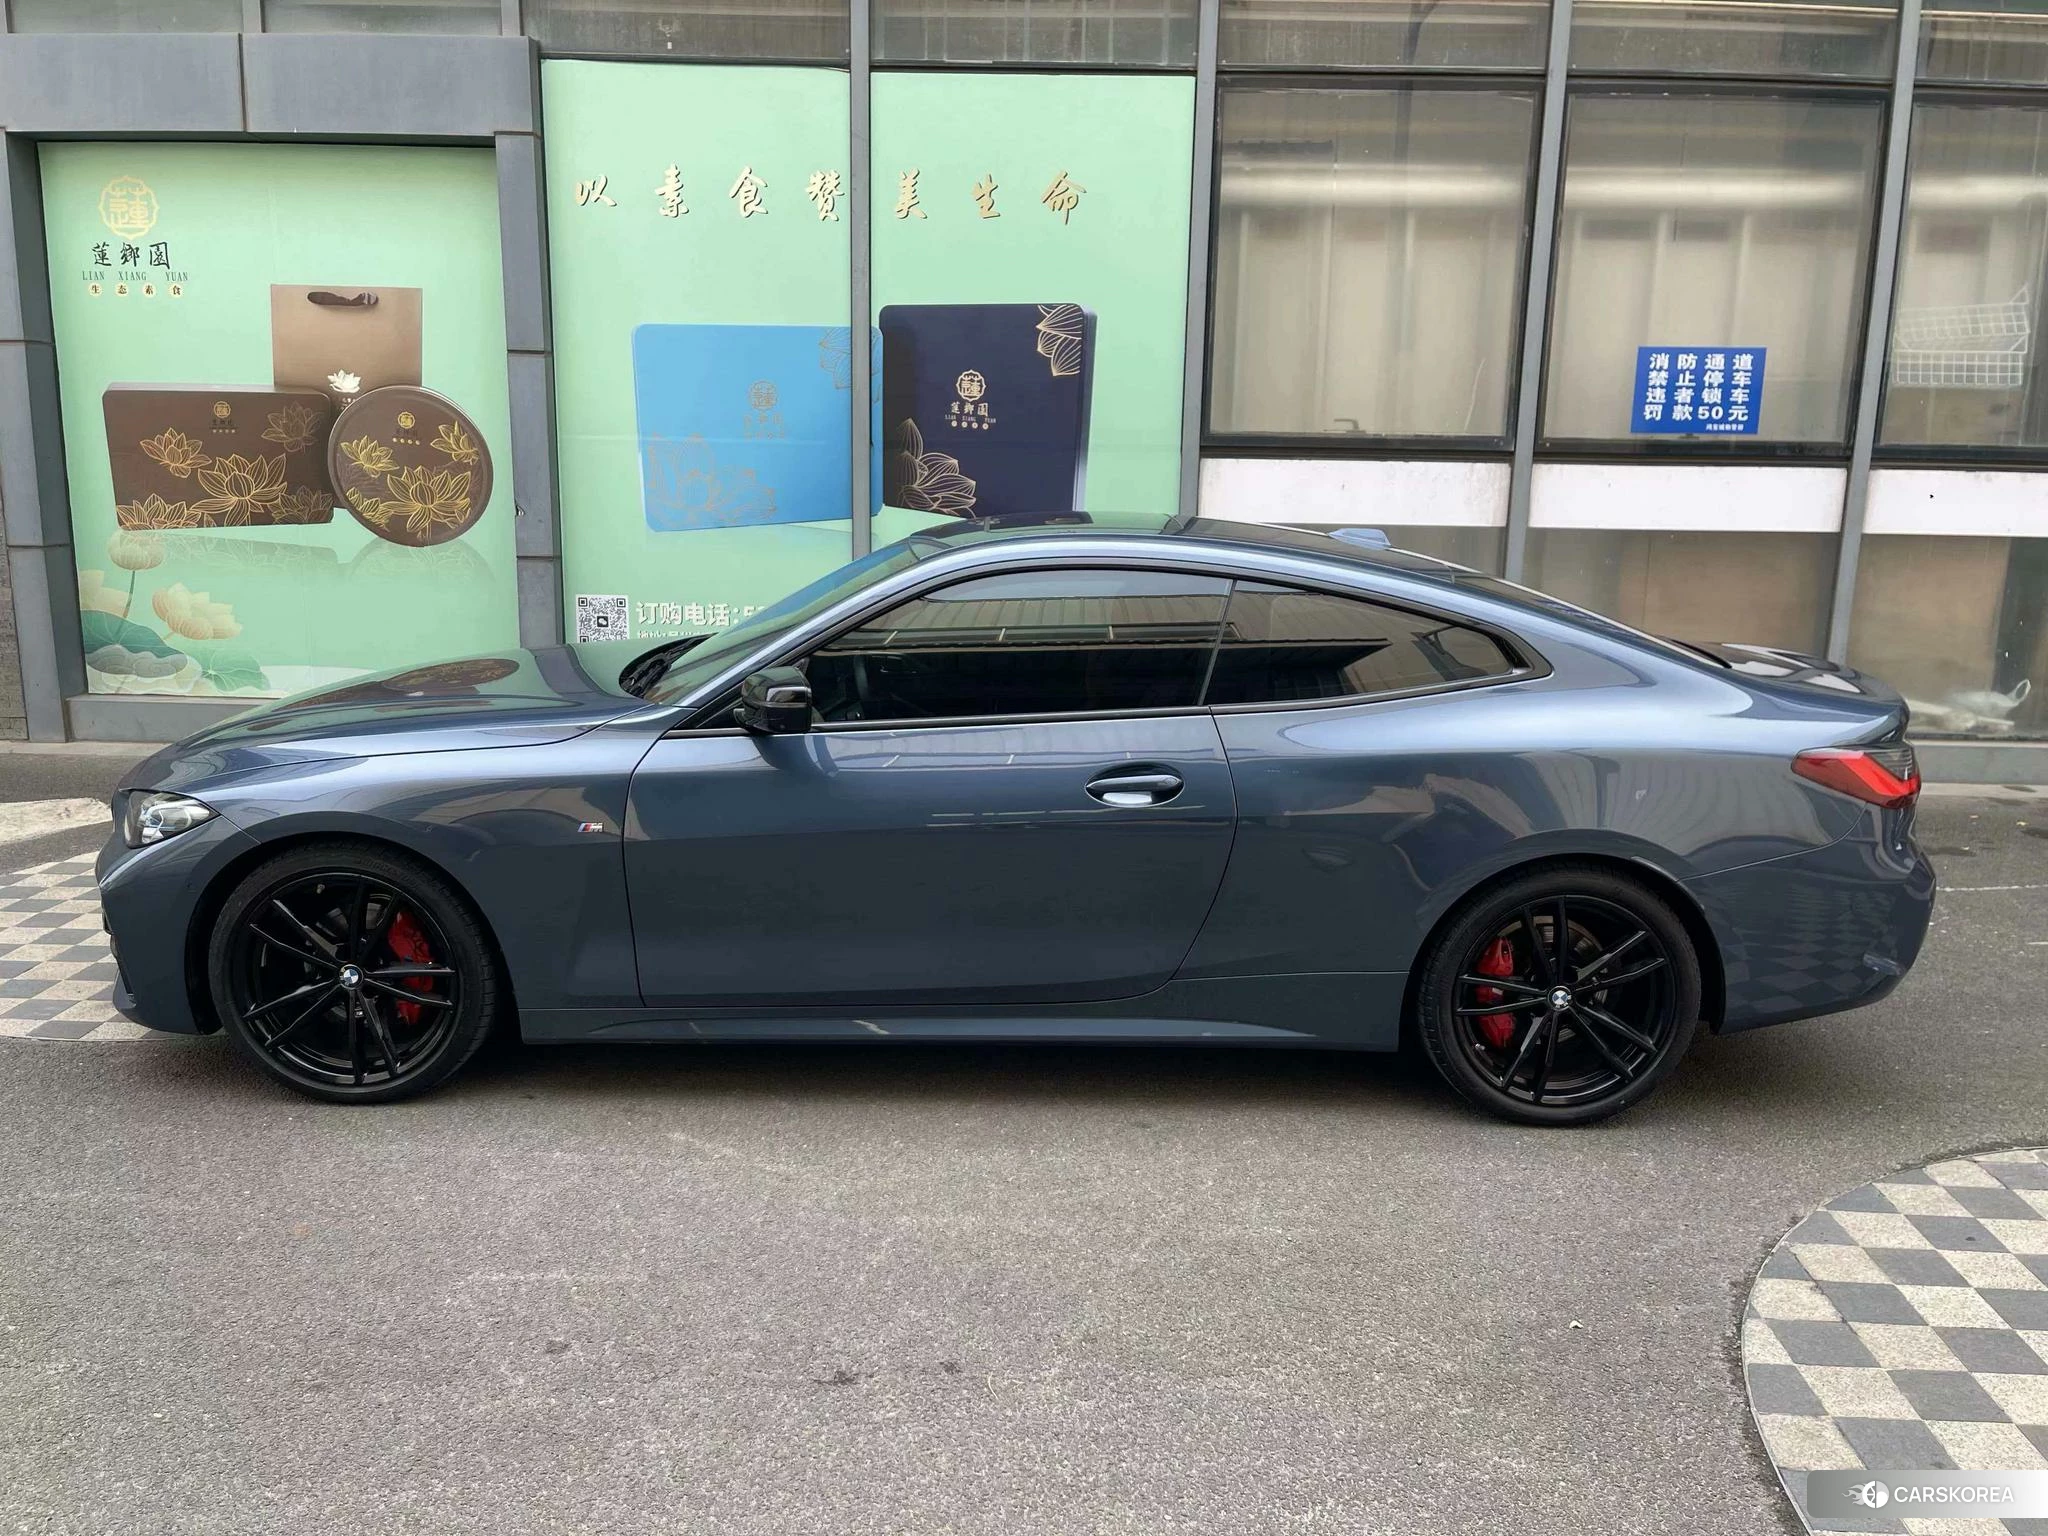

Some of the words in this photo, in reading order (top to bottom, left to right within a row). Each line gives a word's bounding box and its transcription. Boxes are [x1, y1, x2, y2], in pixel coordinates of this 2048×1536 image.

[82, 270, 105, 281] LIAN
[118, 270, 147, 281] XIANG
[165, 271, 188, 282] YUAN
[91, 284, 181, 295] 生态素食
[1649, 353, 1754, 370] 消防通道
[1648, 370, 1752, 387] 禁止停车
[1646, 387, 1750, 404] 违者锁车
[1643, 404, 1749, 421] 罚款50元
